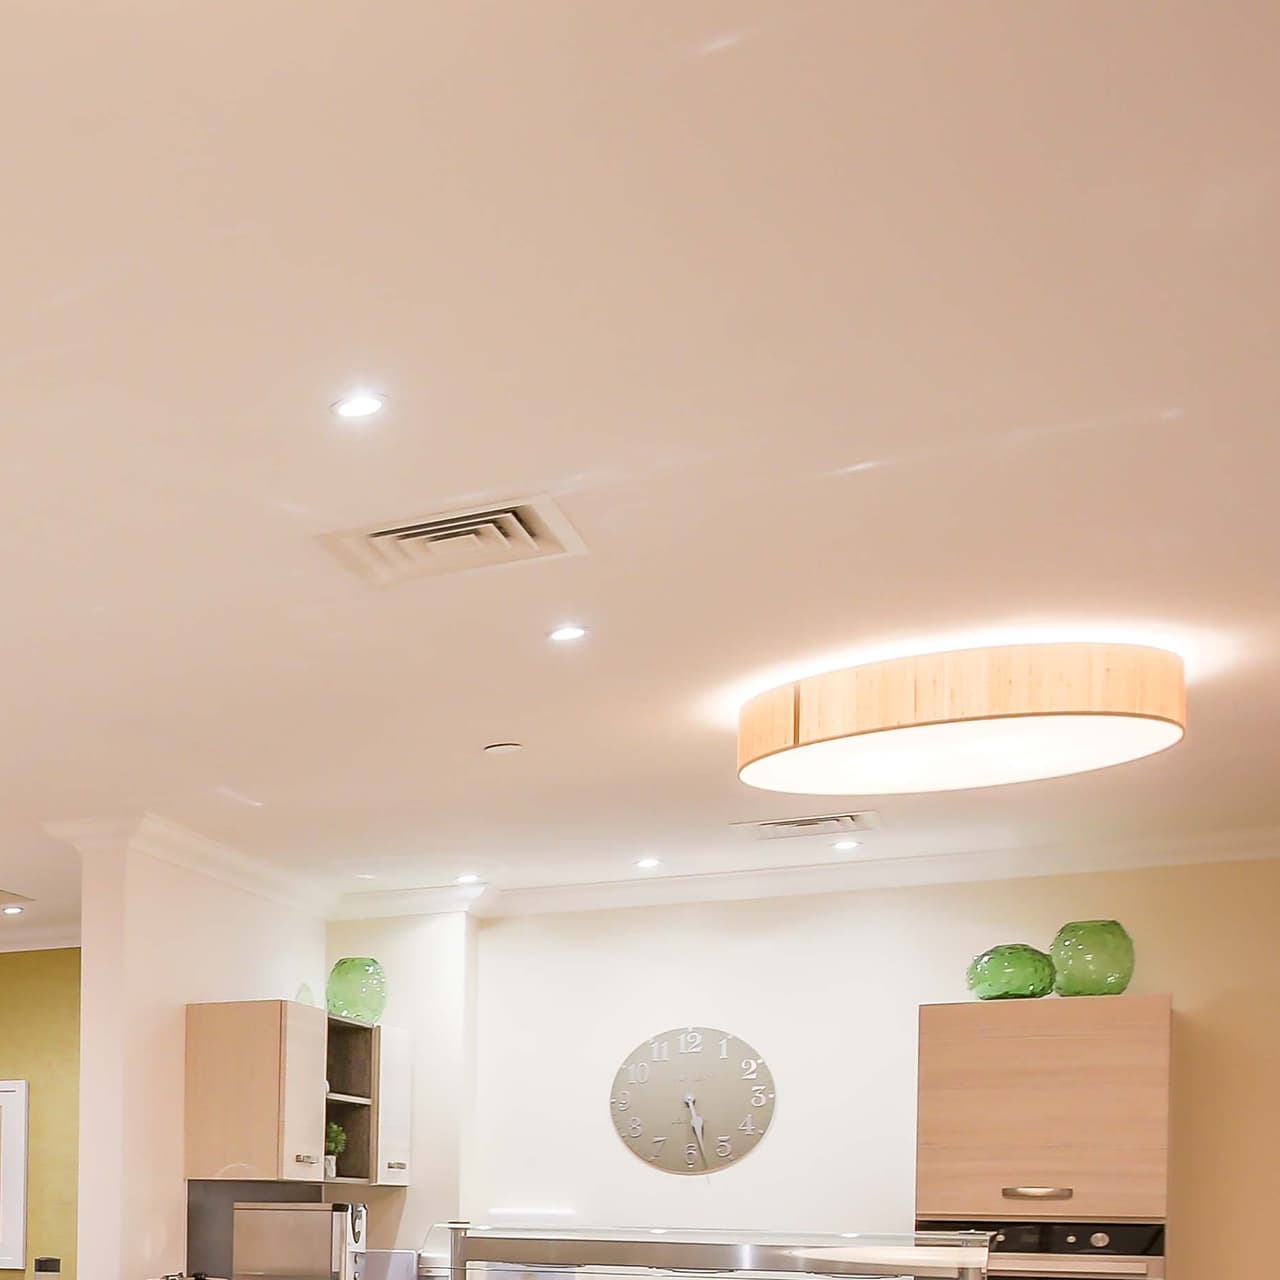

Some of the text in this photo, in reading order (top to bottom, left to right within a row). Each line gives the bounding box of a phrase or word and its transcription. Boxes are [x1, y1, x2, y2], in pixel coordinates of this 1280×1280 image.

[650, 1041, 670, 1063] 11
[677, 1032, 703, 1054] 12
[718, 1038, 729, 1060] 1
[626, 1062, 650, 1085] 10
[741, 1059, 758, 1080] 2
[618, 1090, 631, 1112] 9
[751, 1085, 767, 1107] 3
[629, 1116, 643, 1138] 8
[738, 1113, 756, 1135] 4
[651, 1136, 667, 1158] 7
[685, 1143, 697, 1165] 6
[716, 1135, 733, 1157] 5
